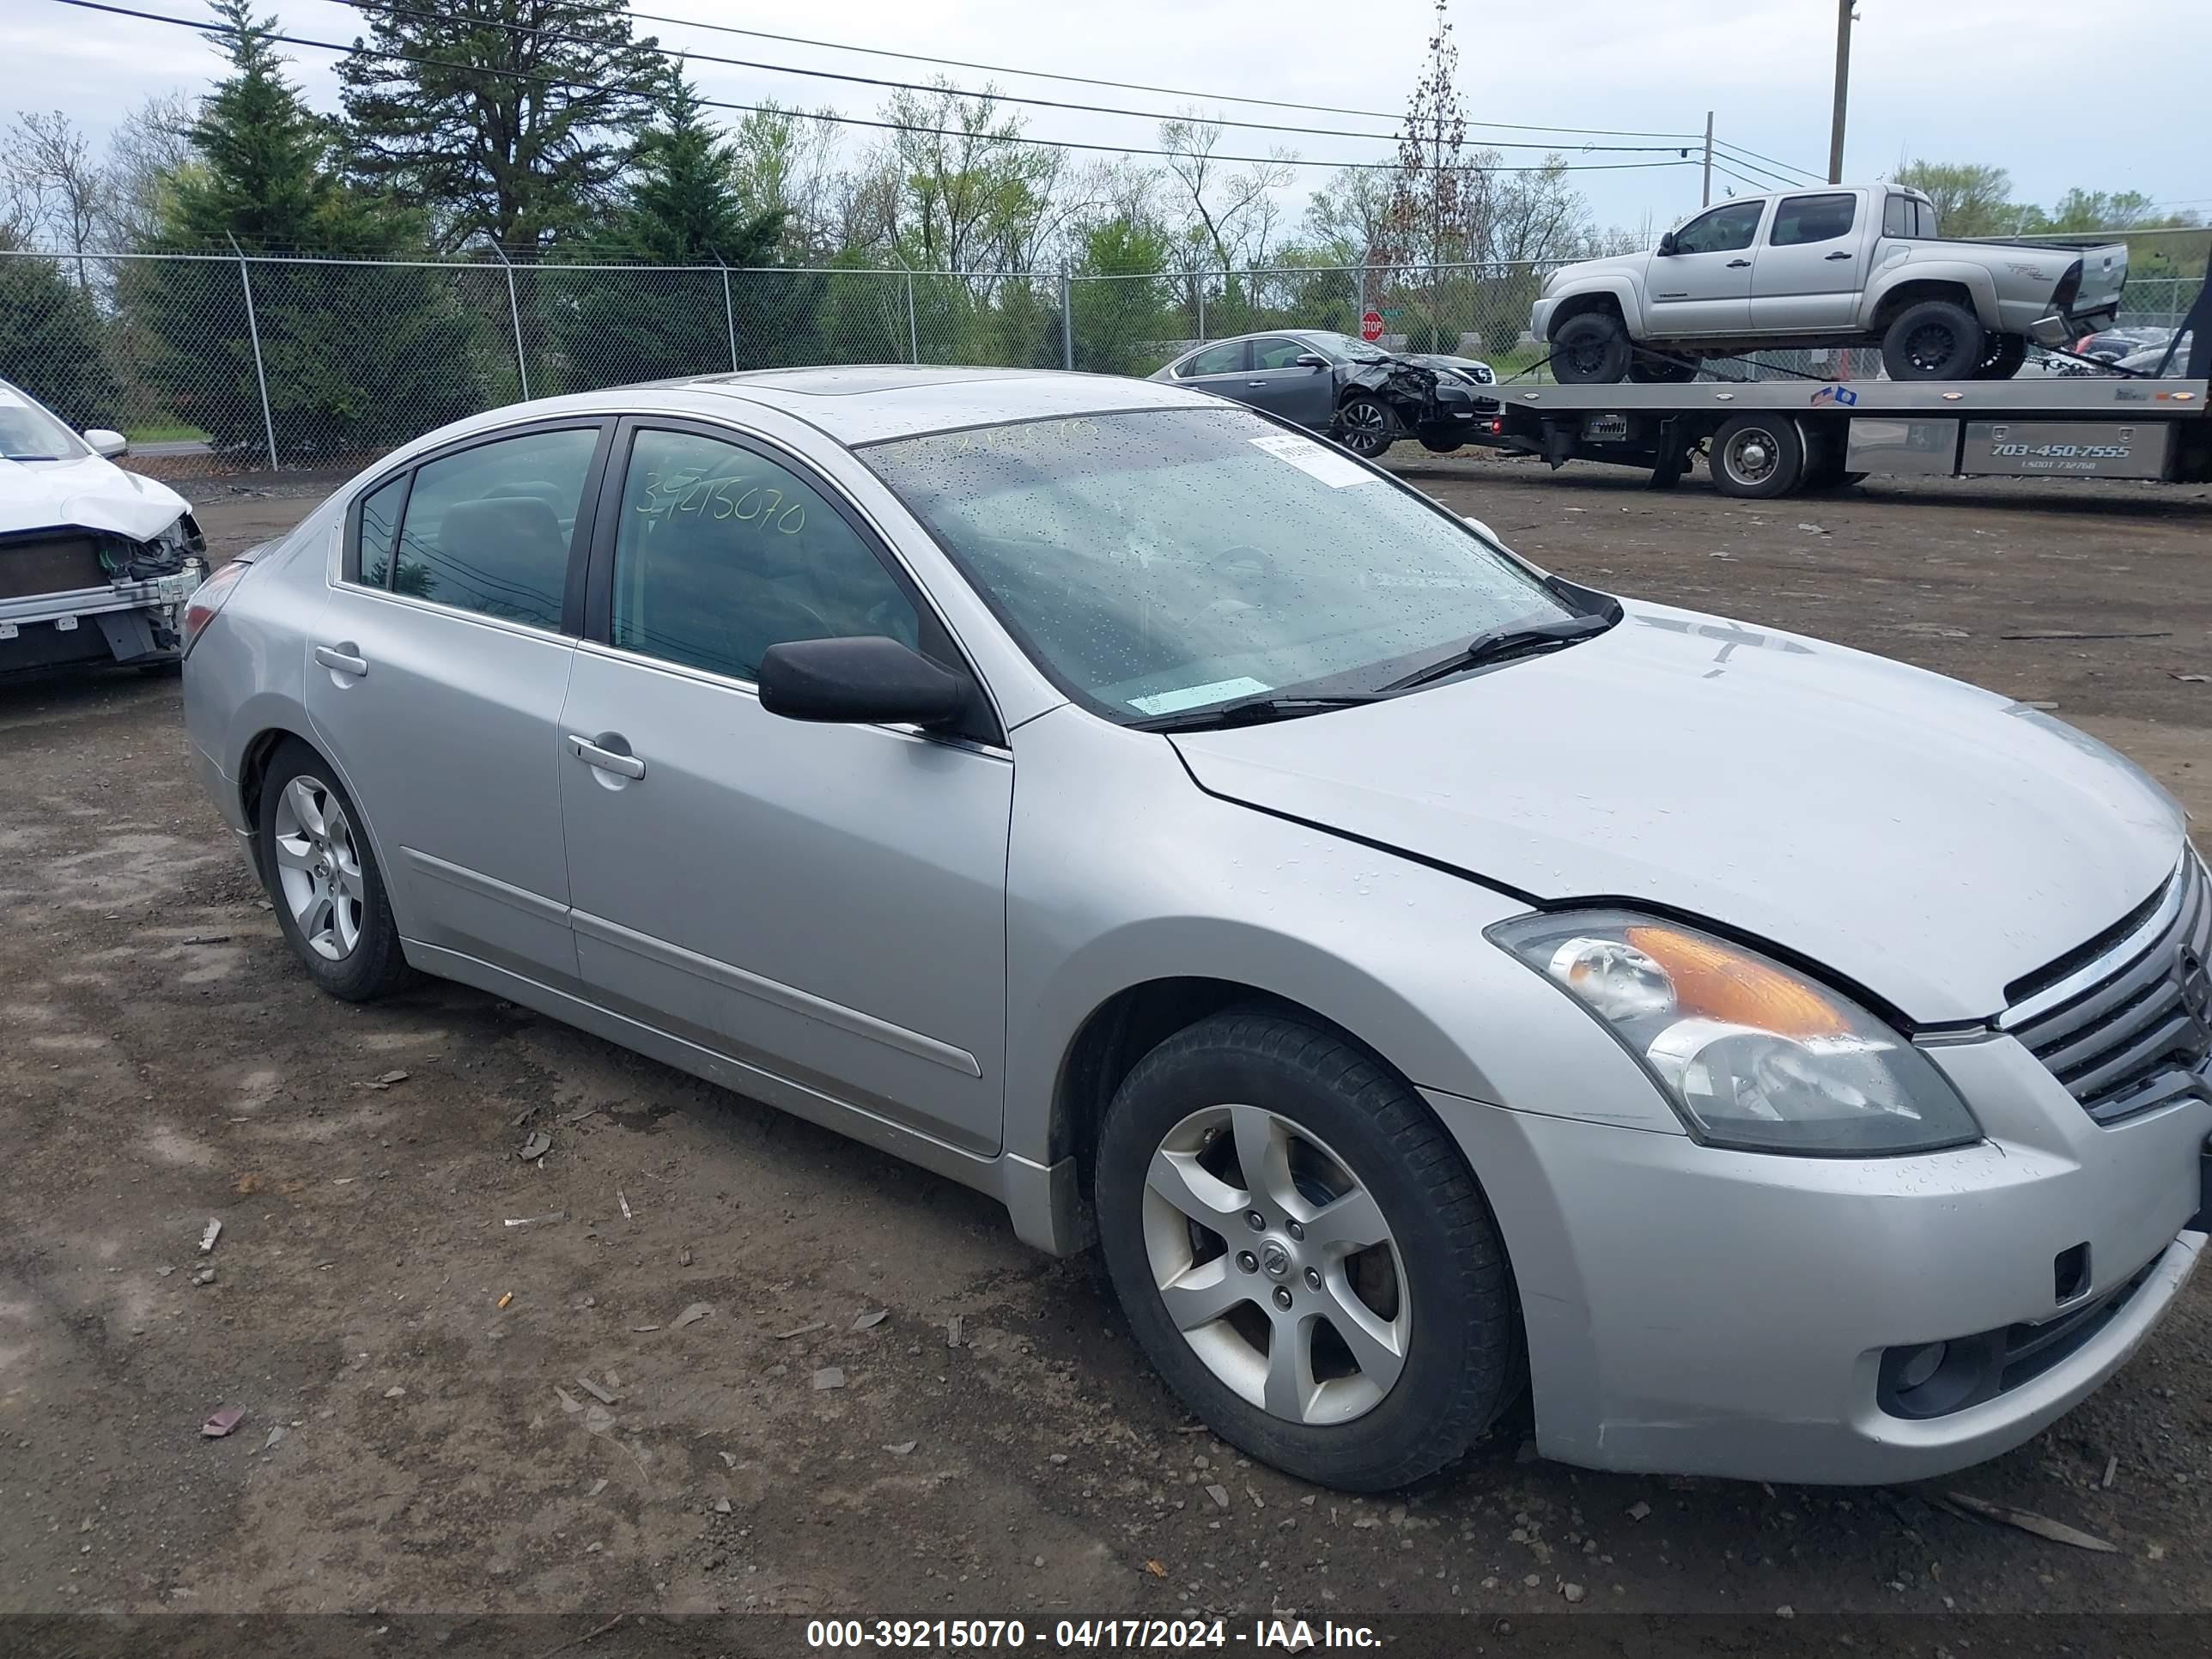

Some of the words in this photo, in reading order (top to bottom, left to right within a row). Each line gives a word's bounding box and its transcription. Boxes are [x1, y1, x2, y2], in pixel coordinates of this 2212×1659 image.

[1362, 320, 1382, 332] STOP
[1990, 444, 2132, 459] 703-450-7555
[635, 471, 805, 535] 39215070
